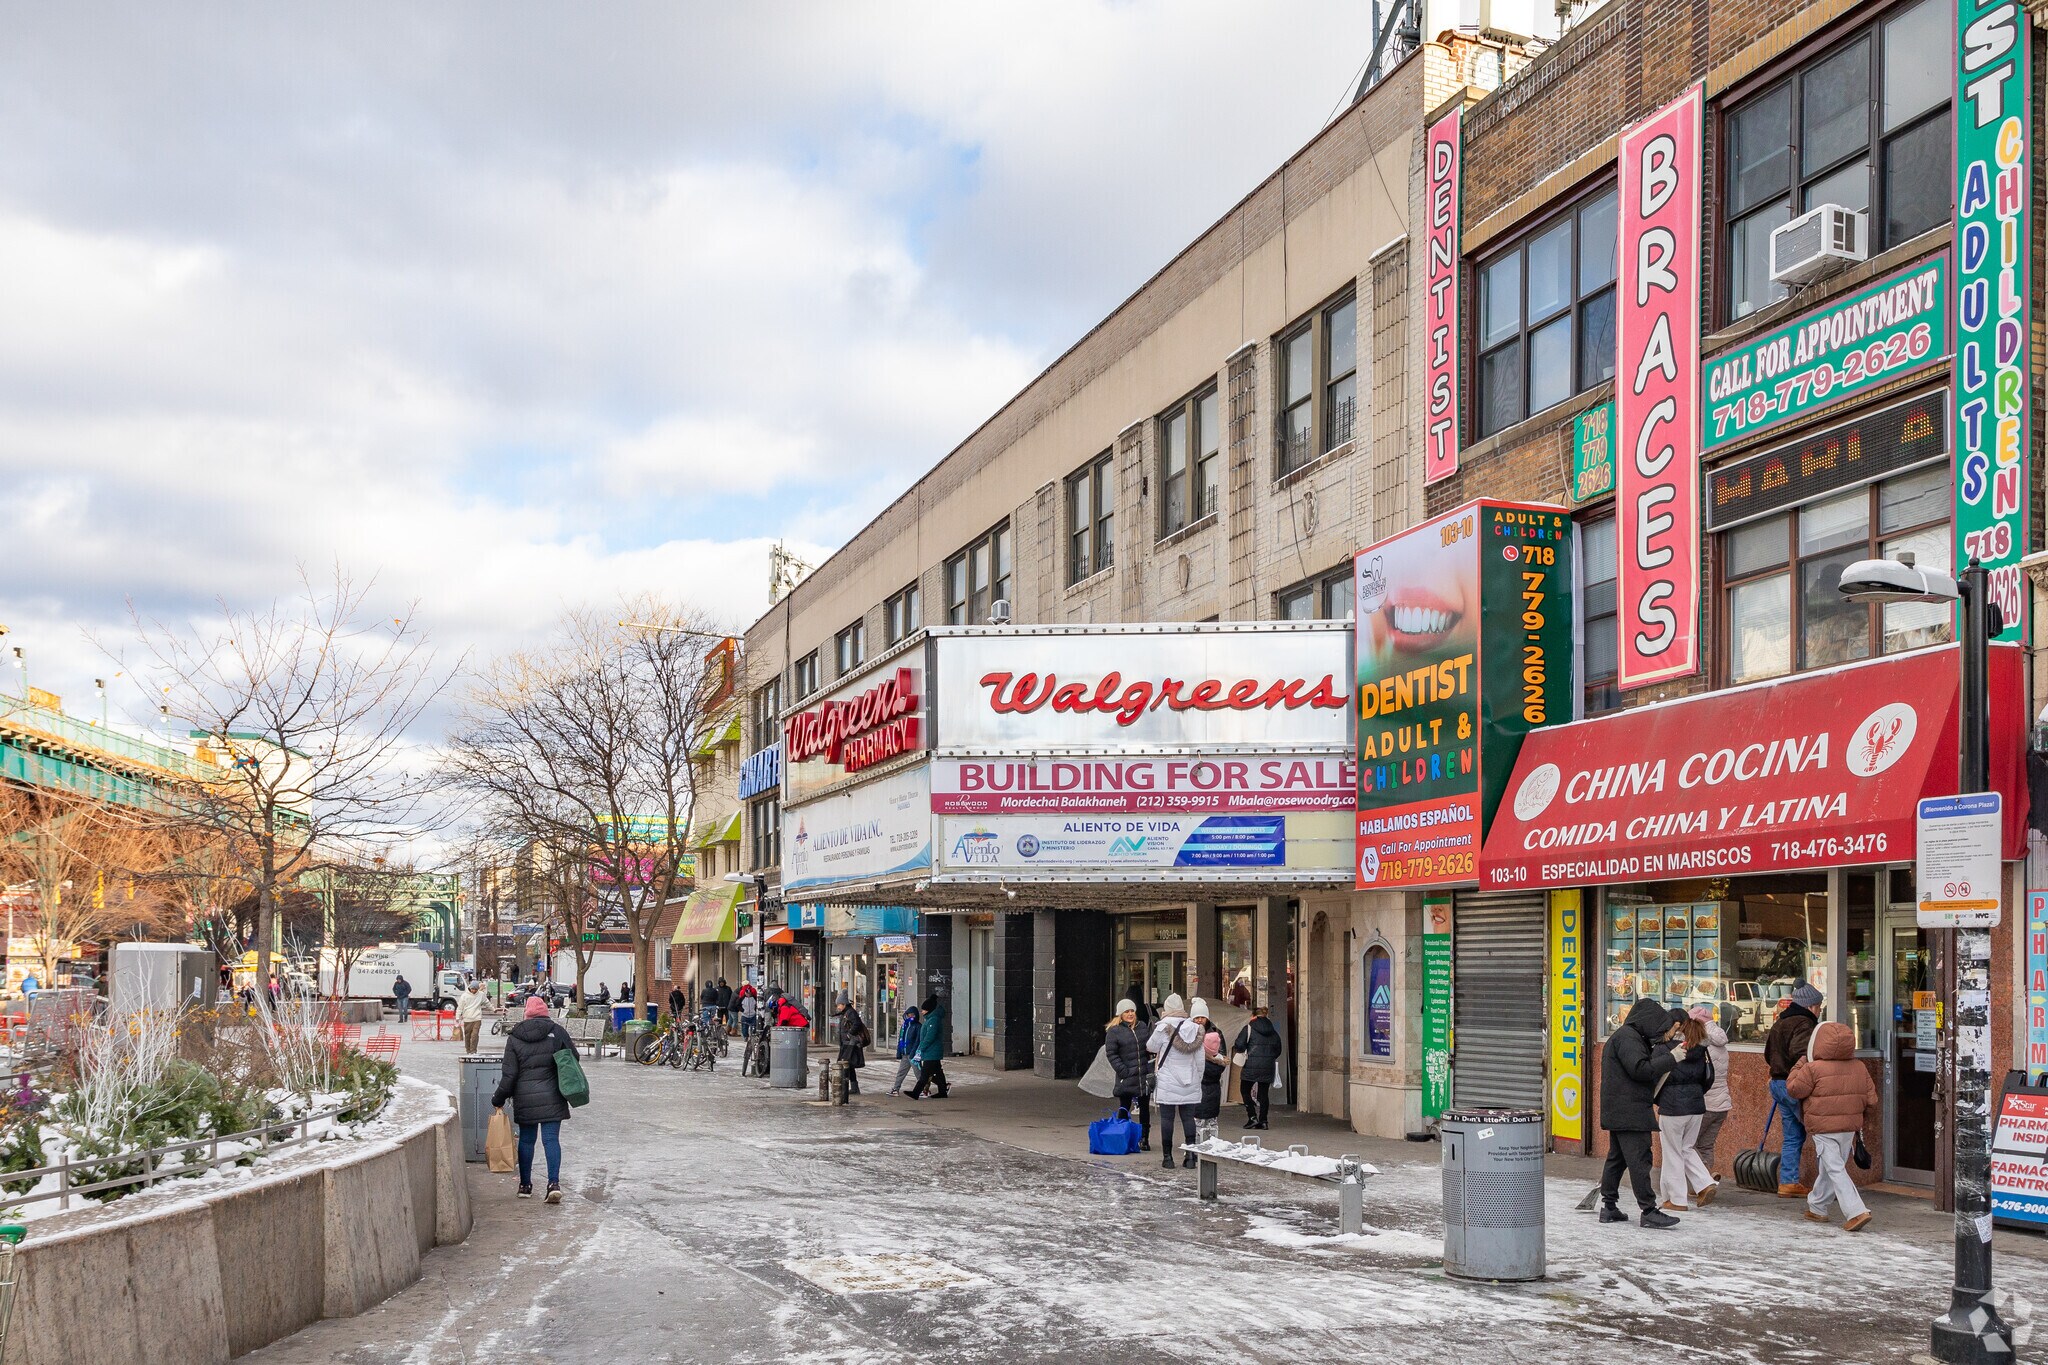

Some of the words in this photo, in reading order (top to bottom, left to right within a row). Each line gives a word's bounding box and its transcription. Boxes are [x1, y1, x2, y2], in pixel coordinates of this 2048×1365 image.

[1429, 140, 1454, 460] DENTIST
[1995, 117, 2022, 517] CHILDREN
[1710, 354, 1751, 402] CALL
[1755, 336, 1790, 383] FOR
[1794, 268, 1938, 366] APPOINTMENT
[1961, 161, 1989, 503] ADULTS
[1634, 133, 1679, 658] BRACES
[1713, 323, 1931, 438] 718-779-2626
[1582, 406, 1608, 443] 718
[1582, 436, 1608, 470] 779
[1578, 461, 1611, 499] 2626
[1440, 515, 1474, 548] 103-10
[1494, 511, 1545, 526] ADULT
[1553, 516, 1562, 527] &
[1494, 525, 1562, 540] CHILDREN
[1522, 545, 1555, 566] 718
[1966, 523, 2011, 562] 718
[1522, 571, 1547, 724] 779-2626
[980, 671, 1350, 727] Walgreens
[1361, 653, 1473, 720] DENTIST
[784, 667, 918, 764] Walgreens
[844, 717, 916, 773] PHARMACY
[1364, 718, 1443, 761] ADULT
[1457, 712, 1472, 740] &
[959, 763, 1154, 791] BUILDING
[1167, 761, 1250, 790] FOR
[1259, 761, 1356, 790] SALE
[1363, 747, 1473, 793] CHILDREN
[1565, 759, 1666, 804] CHINA
[1678, 732, 1830, 789] COCINA
[1000, 796, 1059, 807] Mordechai
[1061, 795, 1127, 807] Balakhaneh
[1136, 796, 1165, 808] (212)
[1167, 796, 1219, 806] 359-9915
[1360, 813, 1418, 836] HABLAMOS
[1420, 804, 1474, 827] ESPAÑOL
[1064, 822, 1122, 833] ALIENTO
[1126, 822, 1144, 833] DE
[1148, 822, 1181, 833] VIDA
[1523, 819, 1617, 851] COMIDA
[1625, 809, 1706, 840] CHINA
[1716, 806, 1736, 830] Y
[1740, 792, 1848, 828] LATINA
[1380, 840, 1397, 855] Call
[1398, 839, 1412, 853] For
[1414, 833, 1472, 853] Appointment
[1771, 832, 1888, 861] 718-476-3476
[1380, 852, 1474, 881] 718-779-2626
[1490, 866, 1528, 884] 103-10
[1542, 856, 1640, 881] ESPECIALIDAD
[1644, 854, 1664, 872] EN
[1667, 846, 1752, 871] MARISCOS
[1562, 910, 1577, 1066] DENTISIT
[1462, 1115, 1481, 1123] Don't
[2012, 1132, 2048, 1144] INSID
